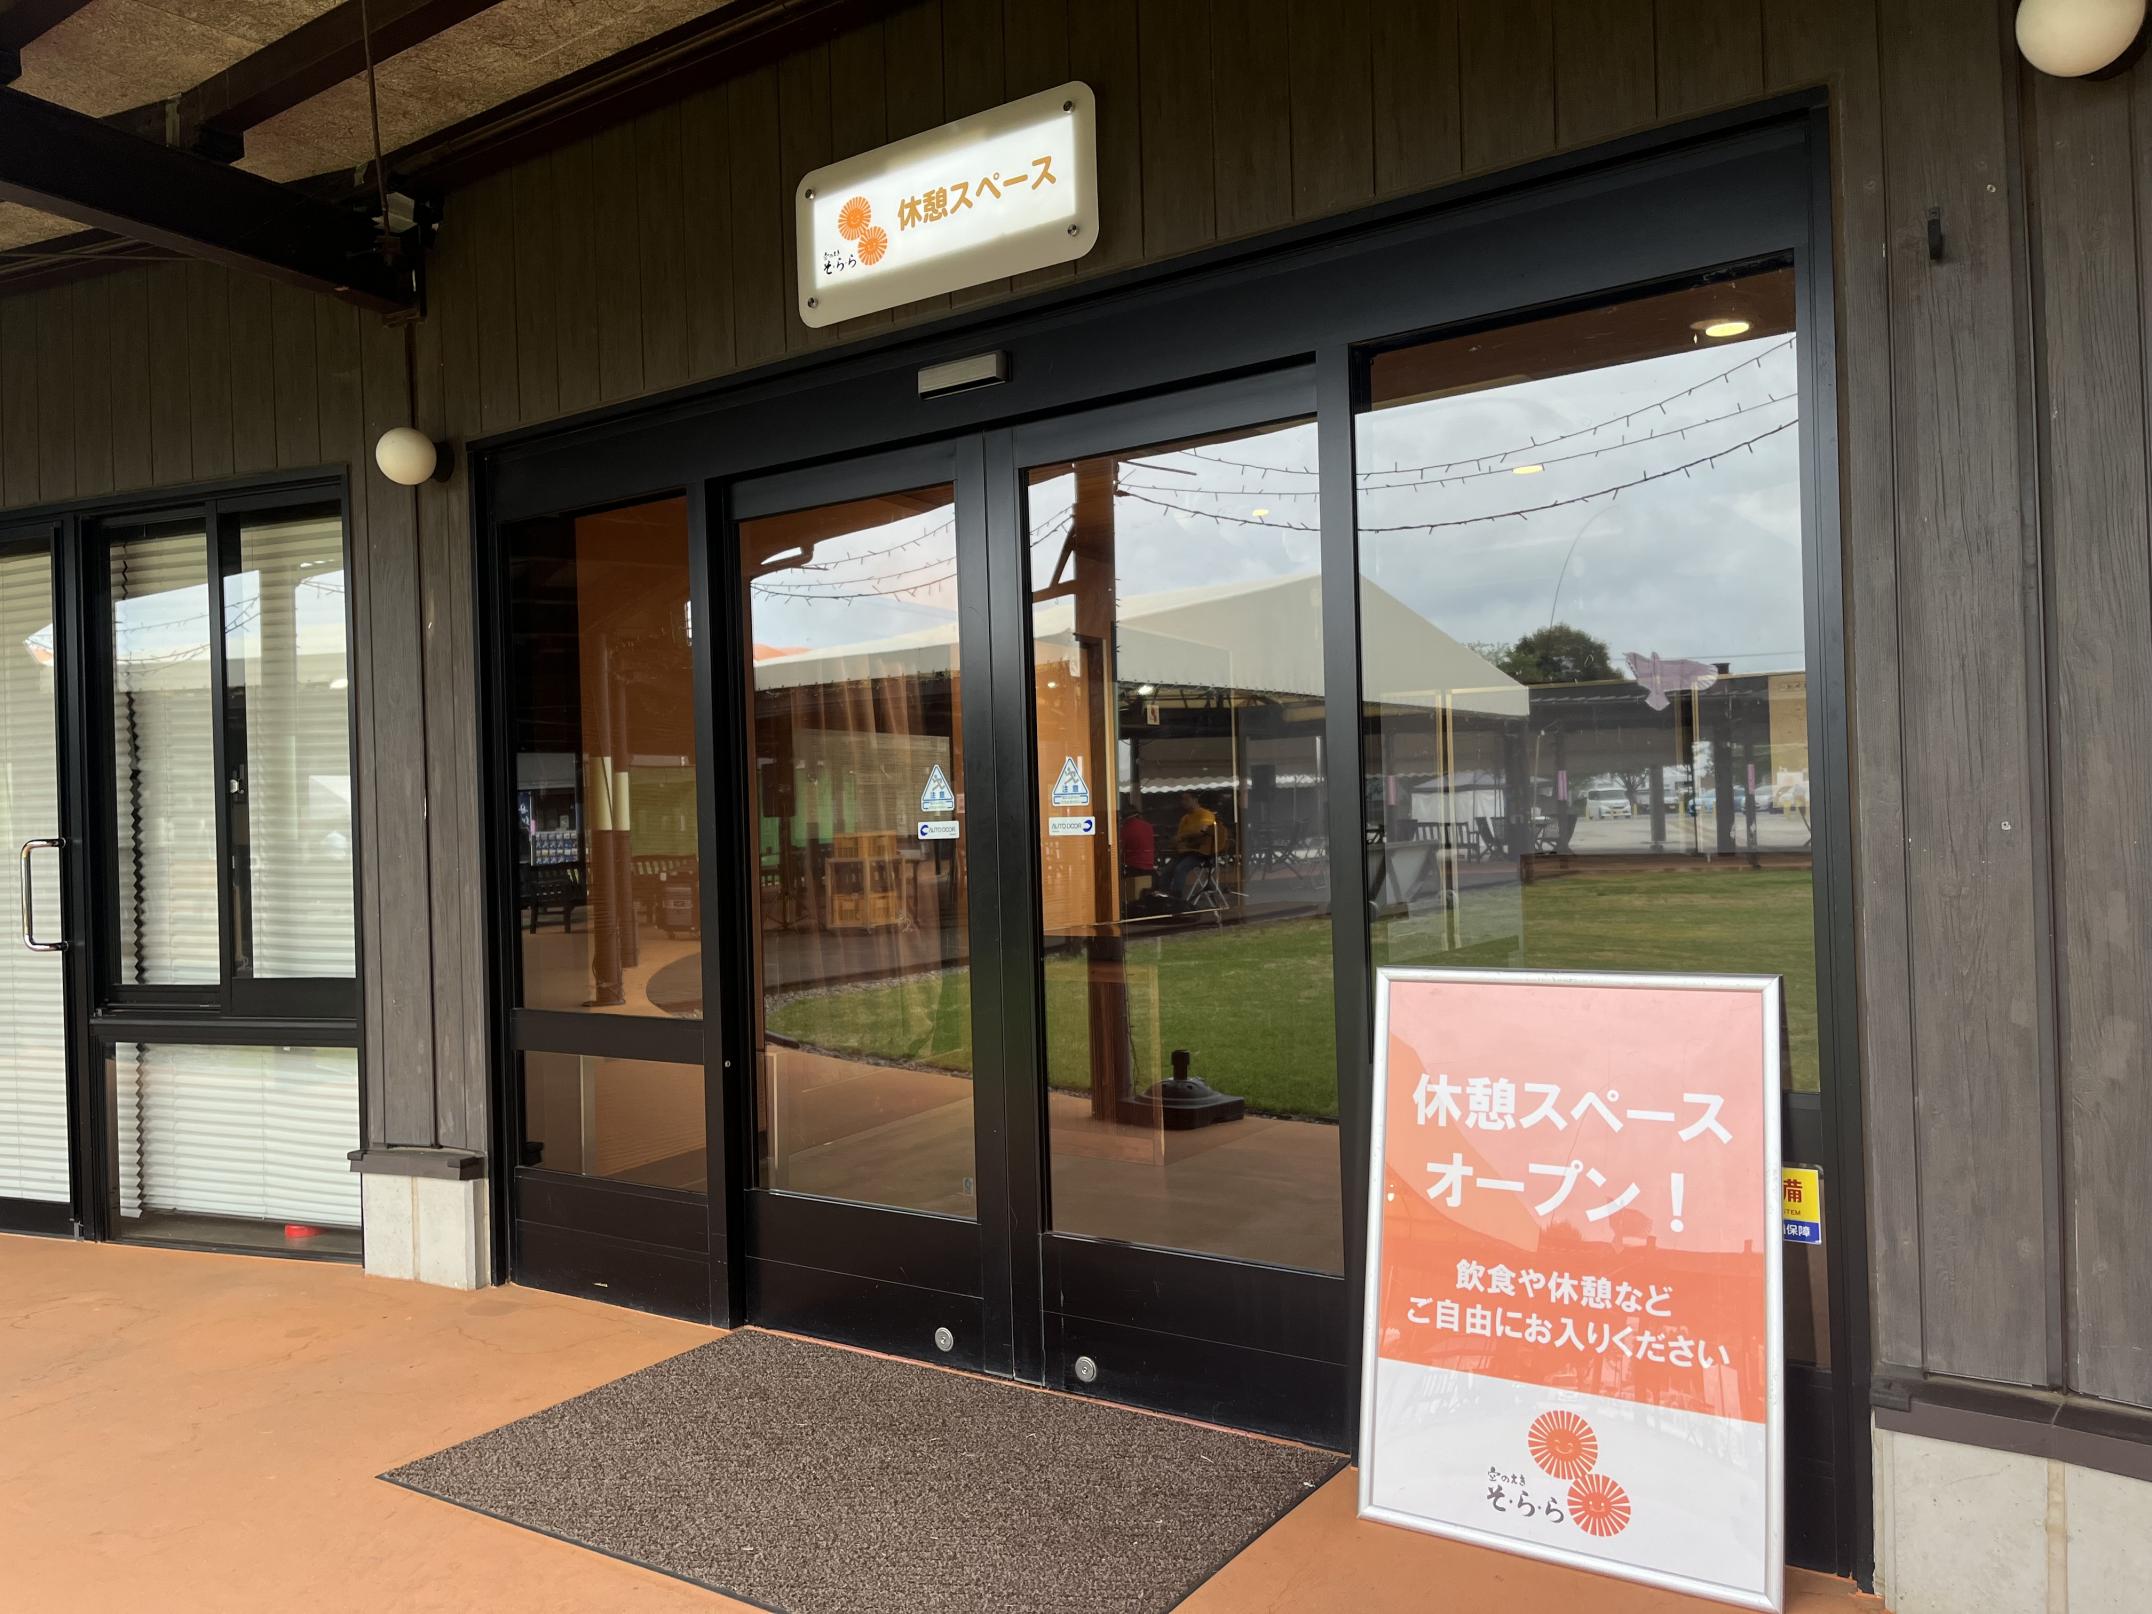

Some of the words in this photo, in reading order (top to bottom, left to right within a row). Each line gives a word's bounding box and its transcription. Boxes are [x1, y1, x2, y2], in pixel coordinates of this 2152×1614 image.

[897, 155, 1057, 231] 休憩スペース
[1412, 1073, 1733, 1144] 休憩スペース
[1426, 1152, 1684, 1233] オープン！
[1783, 1223, 1811, 1237] 保障
[1455, 1258, 1673, 1318] 飲食や休憩など
[1407, 1296, 1731, 1369] ご自由にお入りください
